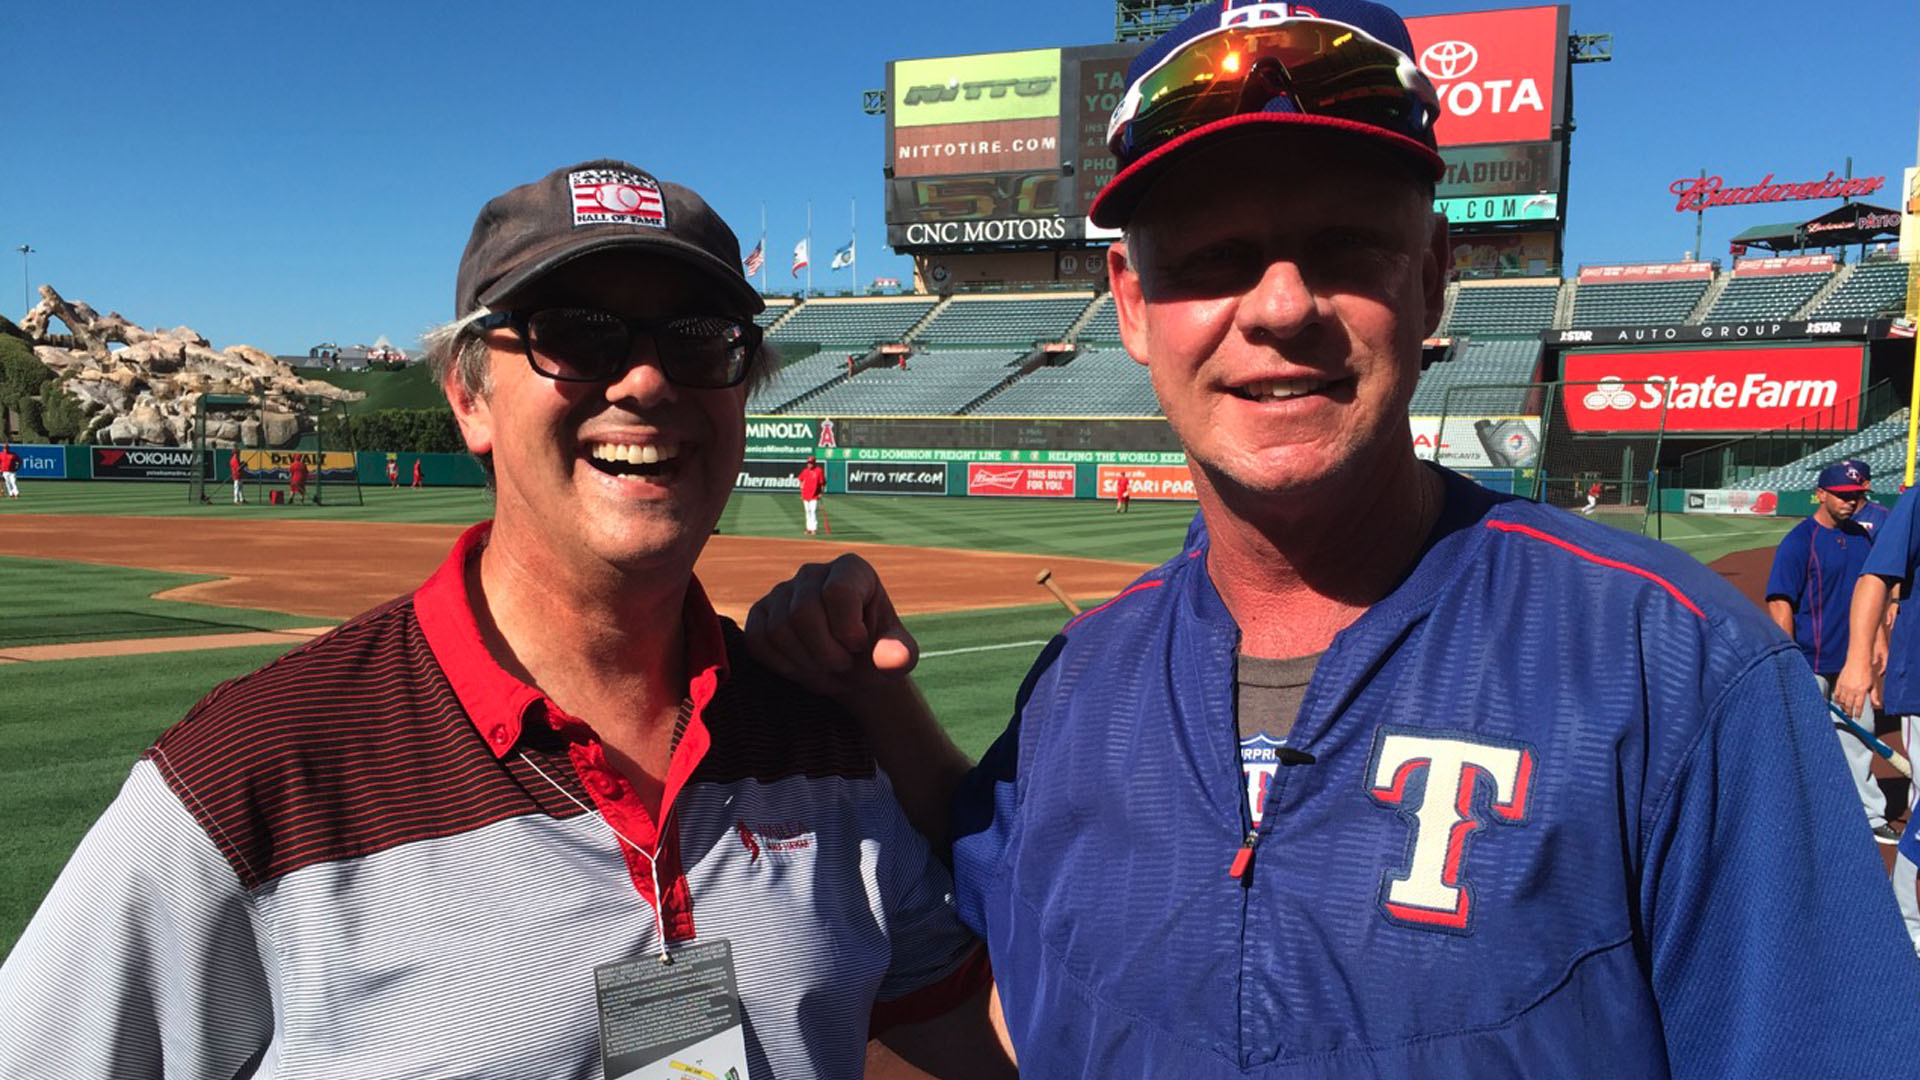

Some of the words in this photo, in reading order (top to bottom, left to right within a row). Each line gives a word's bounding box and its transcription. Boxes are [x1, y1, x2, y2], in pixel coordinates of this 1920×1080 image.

[899, 137, 1056, 158] NITTOTIRE.COM
[1669, 171, 1885, 212] Budweiser
[577, 214, 608, 222] HALL
[1858, 212, 1901, 230] PATIO
[907, 222, 958, 243] CNC
[963, 218, 1065, 241] MOTORS
[1618, 328, 1676, 340] AUTO
[1702, 324, 1781, 338] GROUP
[1640, 375, 1739, 410] State
[1738, 373, 1837, 408] Farm
[745, 423, 813, 438] MINOLTA
[859, 449, 879, 459] OLD
[881, 449, 931, 459] DOMINION
[934, 450, 976, 460] FREIGHT
[979, 450, 1002, 460] LINE
[1048, 451, 1093, 461] HELPING
[1095, 452, 1116, 461] THE
[1118, 452, 1158, 462] WORLD
[850, 469, 884, 483] NITTO
[889, 471, 944, 485] TIRE.COM
[1027, 469, 1046, 480] THIS
[1027, 480, 1044, 490] FOR
[1371, 735, 1532, 928] T
